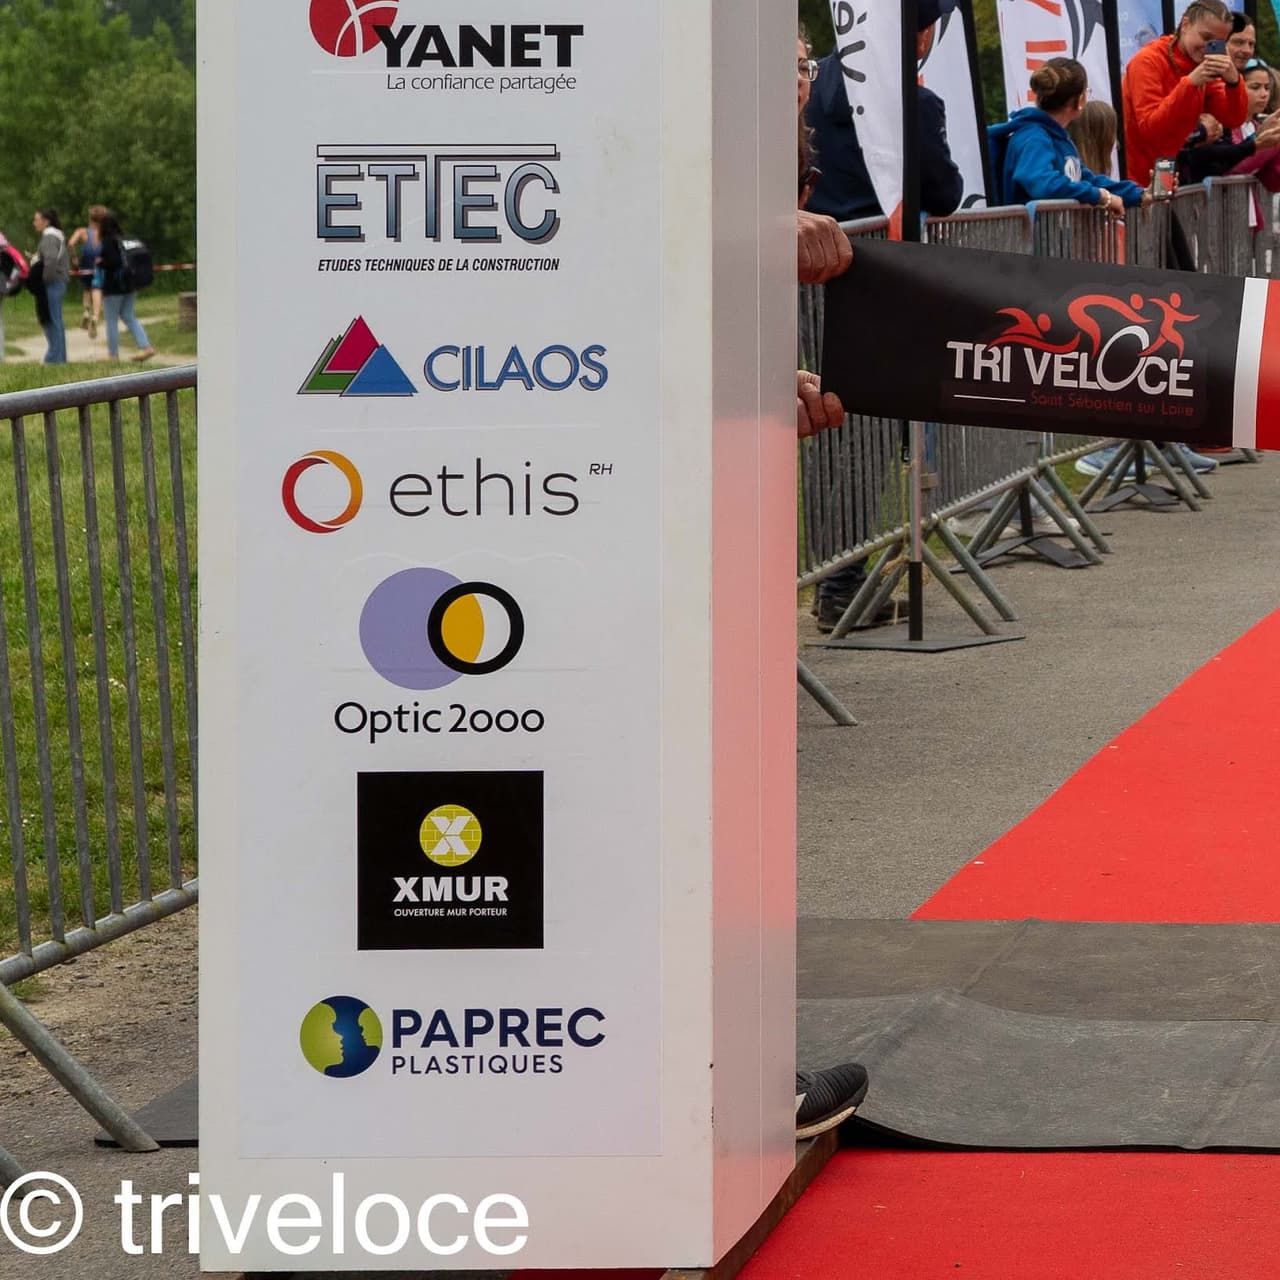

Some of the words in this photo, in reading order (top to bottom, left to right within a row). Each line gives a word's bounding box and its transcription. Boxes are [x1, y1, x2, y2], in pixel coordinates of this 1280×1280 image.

[375, 24, 584, 67] YANET
[388, 74, 405, 89] La
[412, 74, 494, 89] confiance
[500, 73, 576, 94] partagée
[317, 144, 560, 244] ETTEC
[318, 259, 361, 271] ETUDES
[365, 258, 436, 272] TECHNIQUES
[439, 258, 454, 272] DE
[457, 258, 470, 272] LA
[473, 259, 559, 271] CONSTRUCTION
[424, 345, 608, 391] CILAOS
[947, 341, 1011, 382] TRI
[1024, 325, 1193, 397] VELOCE
[1031, 390, 1063, 407] Saint
[1069, 393, 1132, 413] Sébastien
[1138, 403, 1154, 414] sur
[1162, 401, 1194, 418] Loire
[390, 458, 578, 516] ethis
[590, 464, 612, 475] RH
[335, 702, 441, 744] Optic
[449, 704, 544, 732] 2000
[393, 876, 508, 902] XMUR
[394, 908, 445, 916] OUVERTURE
[447, 908, 467, 916] MUR
[469, 908, 508, 916] PORTEUR
[393, 1008, 605, 1048] PAPREC
[393, 1055, 562, 1074] PLASTIQUES
